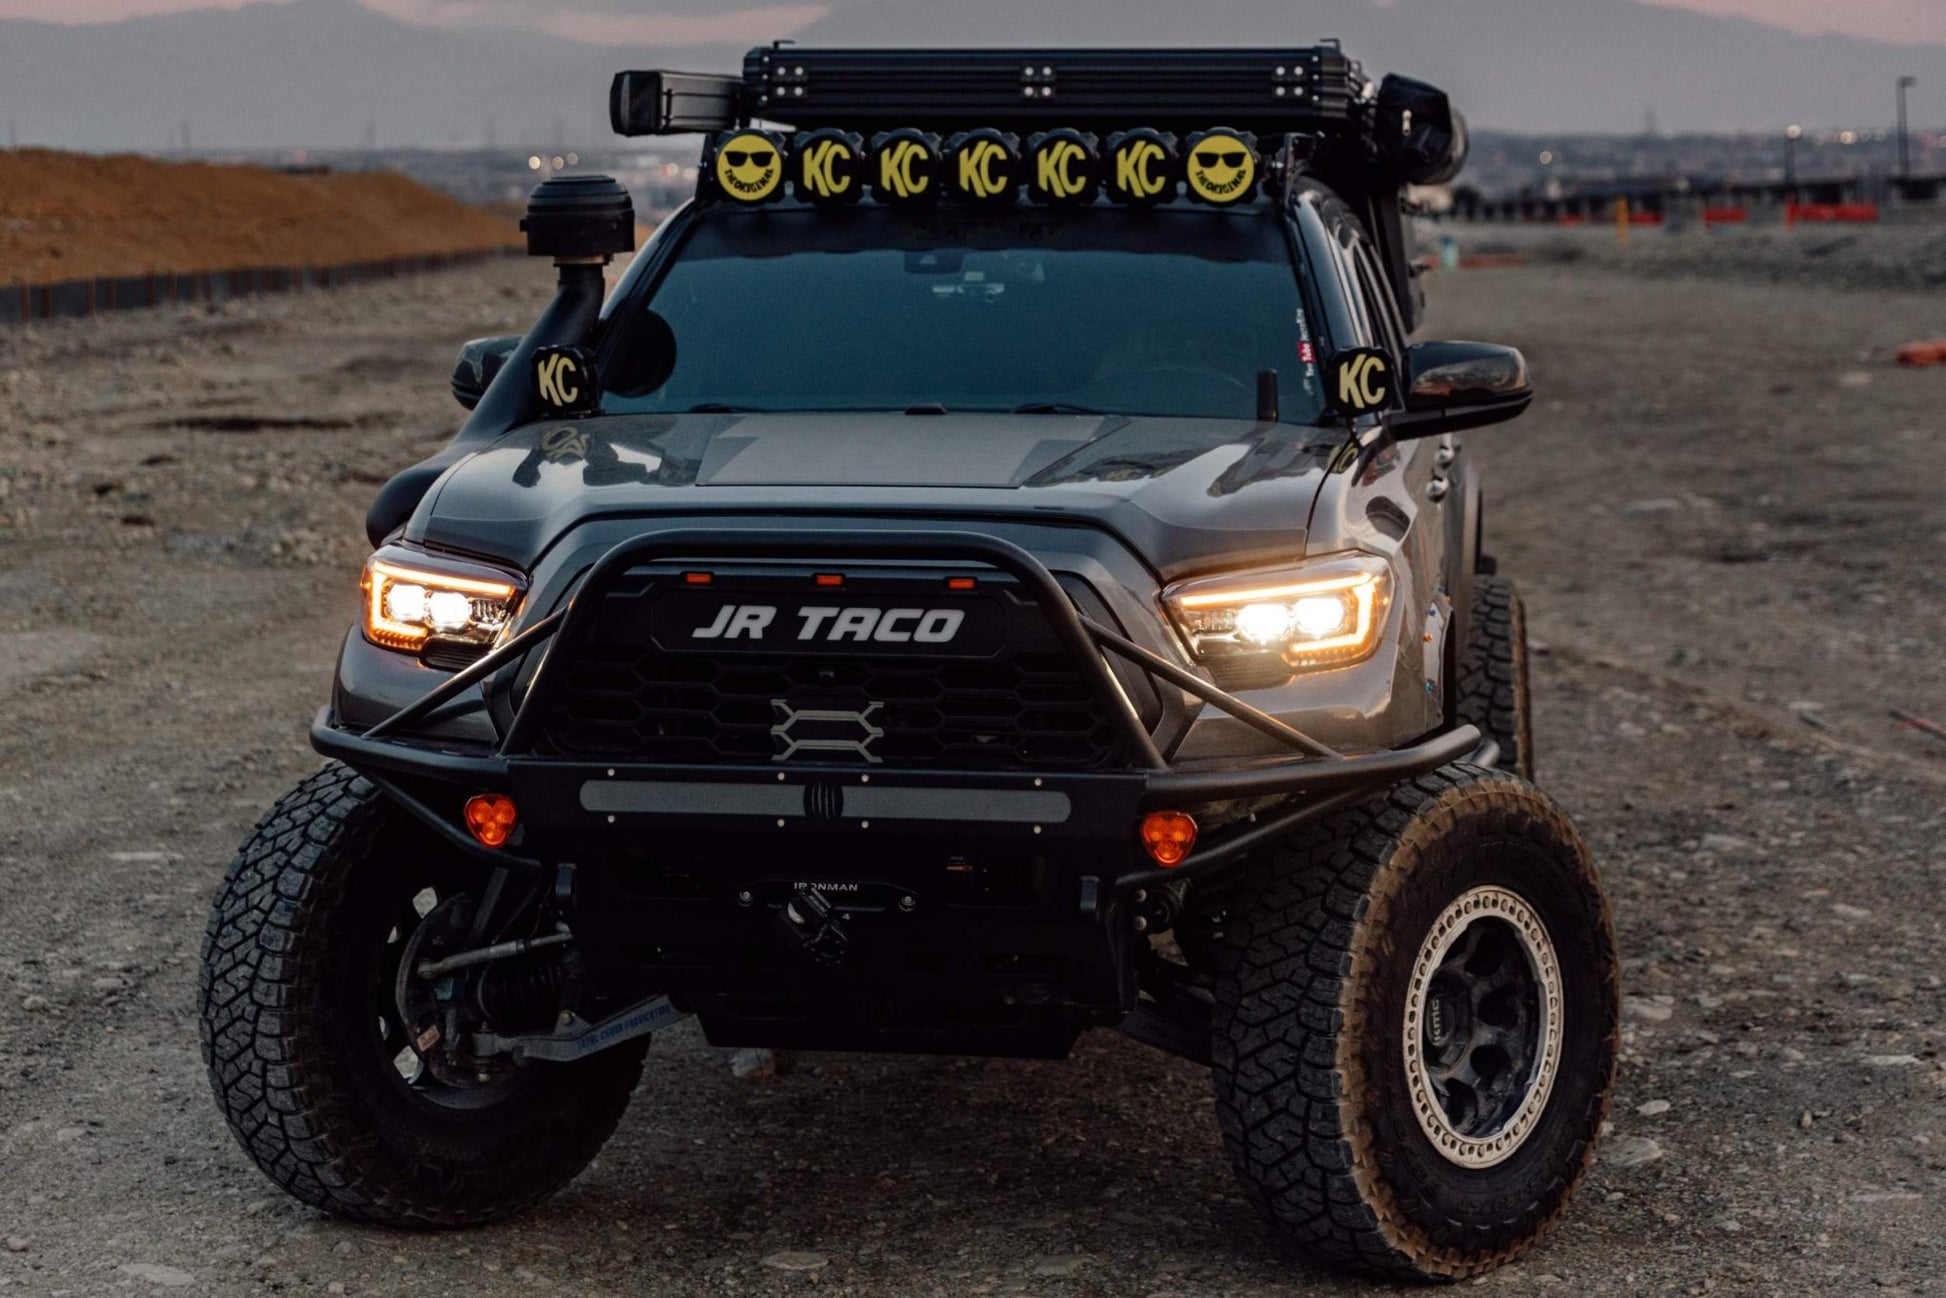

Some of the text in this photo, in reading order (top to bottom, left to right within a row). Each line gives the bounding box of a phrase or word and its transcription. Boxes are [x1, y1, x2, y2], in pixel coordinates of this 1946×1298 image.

[803, 141, 851, 197] KC
[881, 141, 928, 197] KC
[959, 141, 1007, 198] KC
[1037, 141, 1086, 197] KC
[1116, 141, 1165, 197] KC
[538, 353, 578, 406] KC
[1339, 353, 1386, 409] KC
[692, 605, 965, 643] JR TACO
